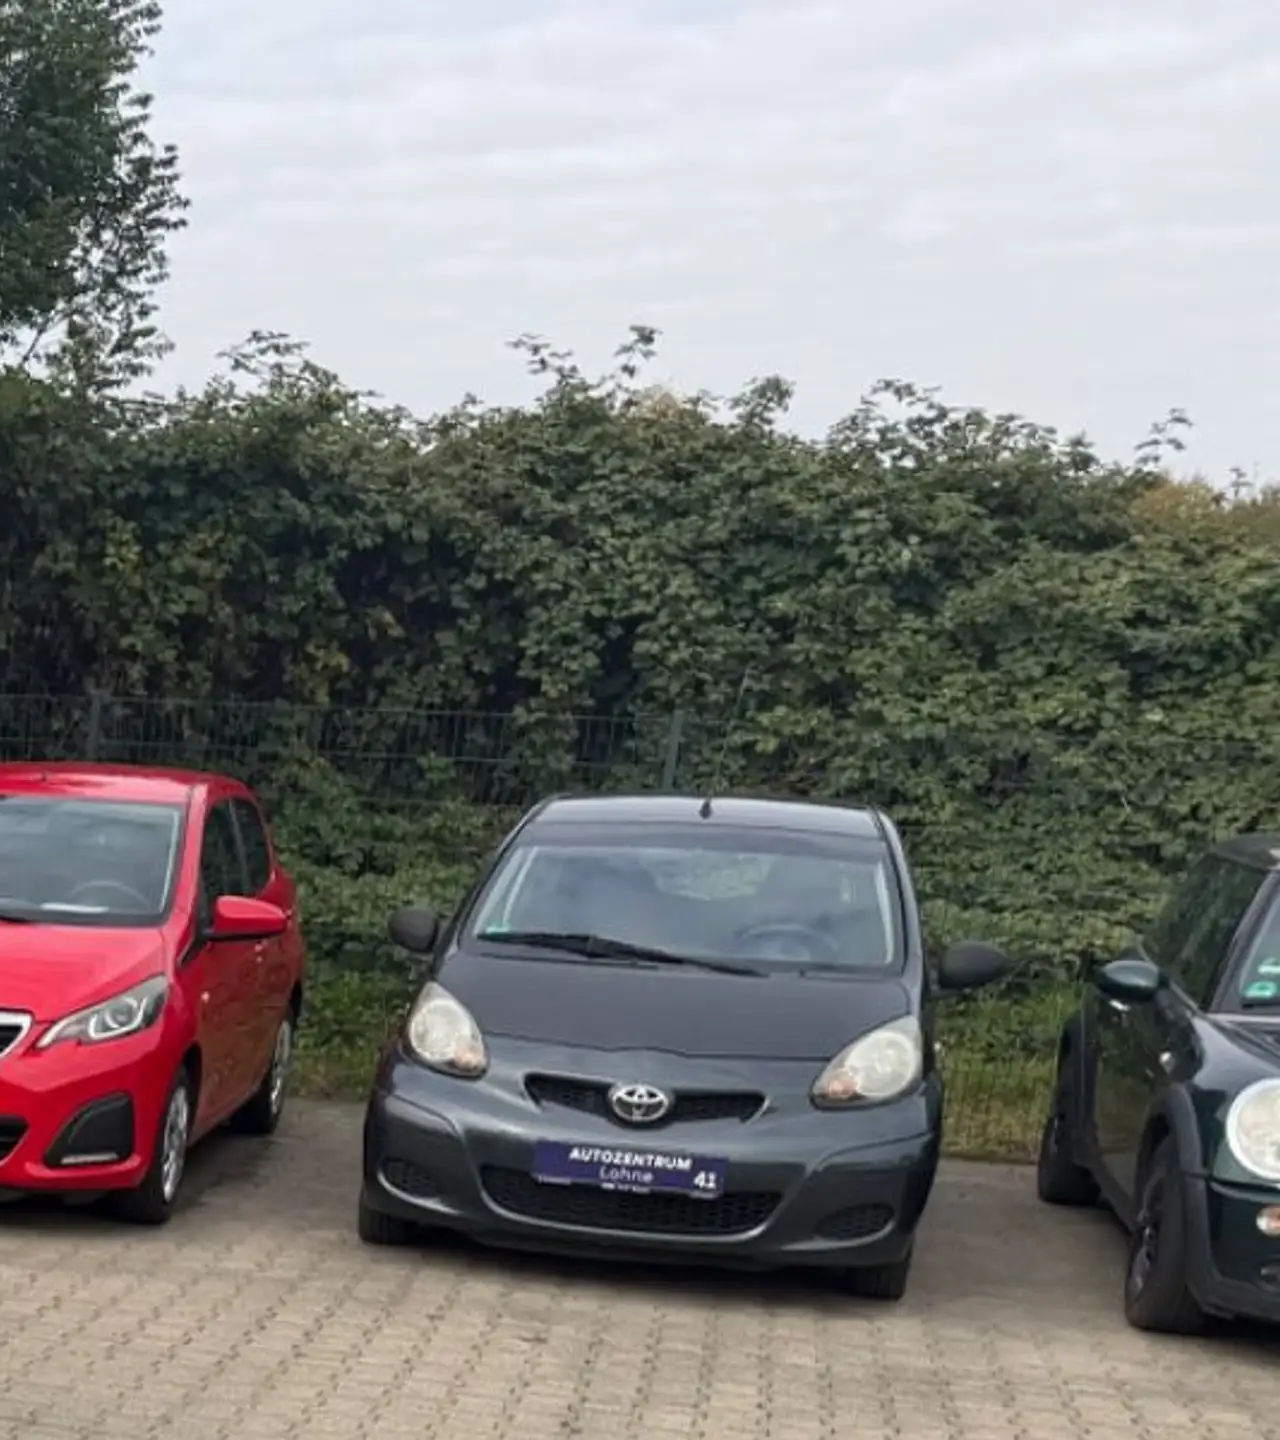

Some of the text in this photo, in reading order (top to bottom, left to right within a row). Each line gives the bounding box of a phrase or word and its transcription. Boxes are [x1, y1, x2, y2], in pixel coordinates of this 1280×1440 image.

[569, 1147, 694, 1172] AUTOZENTRUM
[599, 1166, 654, 1184] Lohne
[692, 1170, 718, 1189] 41
